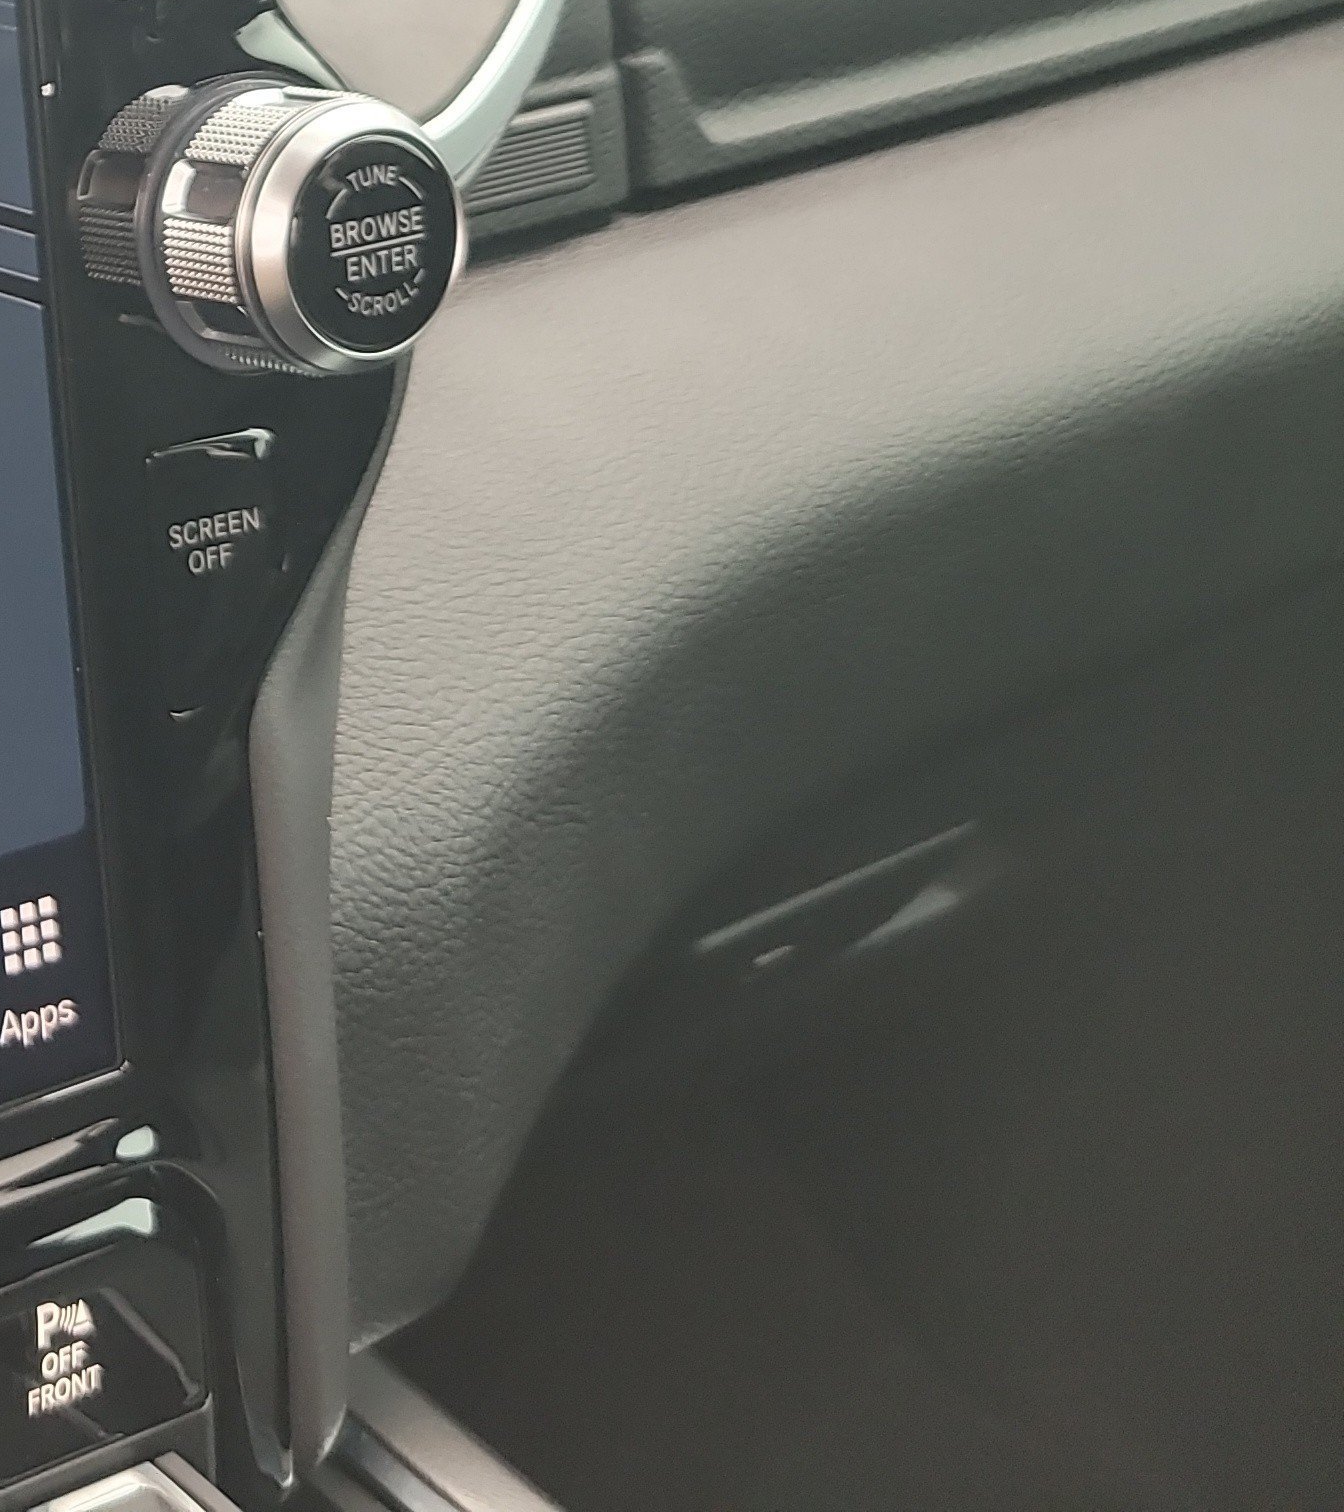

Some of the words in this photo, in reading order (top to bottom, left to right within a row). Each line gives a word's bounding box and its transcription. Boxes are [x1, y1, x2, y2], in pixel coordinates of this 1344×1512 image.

[346, 164, 400, 192] TUNE
[330, 205, 424, 249] BROWSE
[346, 244, 418, 281] ENTER
[348, 281, 420, 316] SCROLL
[169, 506, 261, 550] SCREEN
[188, 543, 234, 574] OFF
[0, 998, 80, 1048] Apps
[41, 1340, 88, 1382] OFF
[28, 1364, 104, 1416] FRONT
